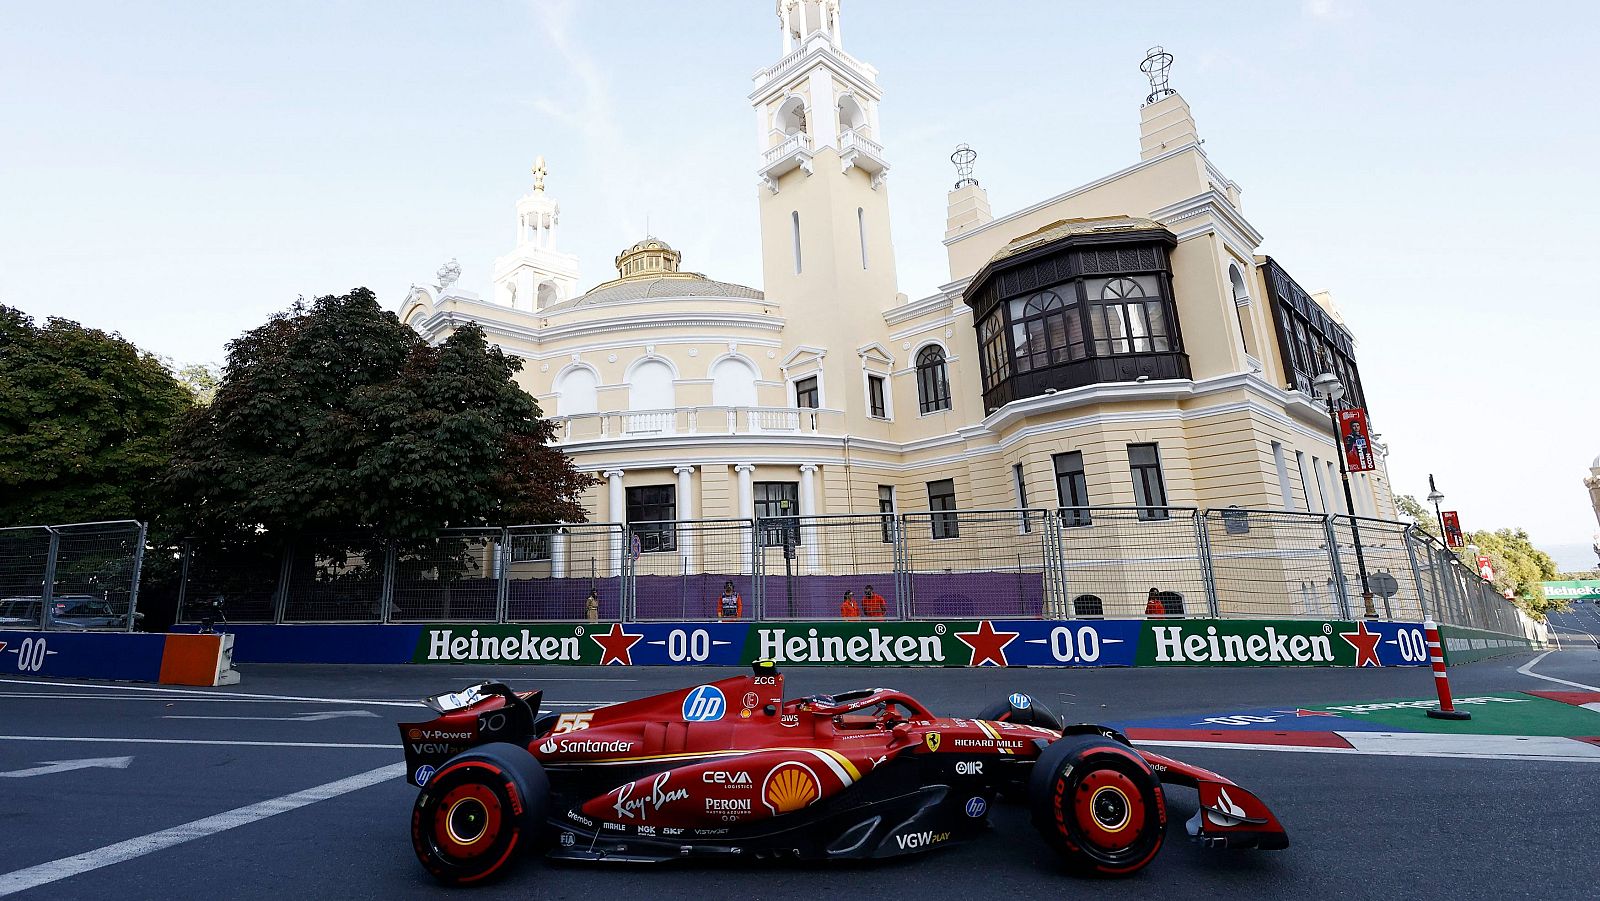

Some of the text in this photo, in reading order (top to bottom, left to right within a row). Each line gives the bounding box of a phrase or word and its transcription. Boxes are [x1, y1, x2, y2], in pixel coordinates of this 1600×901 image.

[668, 629, 710, 662] 0.0
[1050, 626, 1100, 663] 0.0
[1397, 628, 1427, 662] 0.0
[688, 685, 720, 721] hp
[1012, 693, 1029, 709] hp
[551, 712, 595, 736] 55
[422, 730, 472, 739] V-Power
[412, 743, 449, 754] VGW
[560, 739, 634, 753] Santander
[954, 739, 1024, 748] RICHARD MILLE
[705, 798, 751, 810] PERONI
[968, 797, 985, 817] hp
[567, 808, 593, 827] brembo
[603, 822, 626, 831] MAHLE
[637, 825, 656, 833] NGK
[560, 835, 575, 844] FIA
[896, 831, 933, 850] VGW
